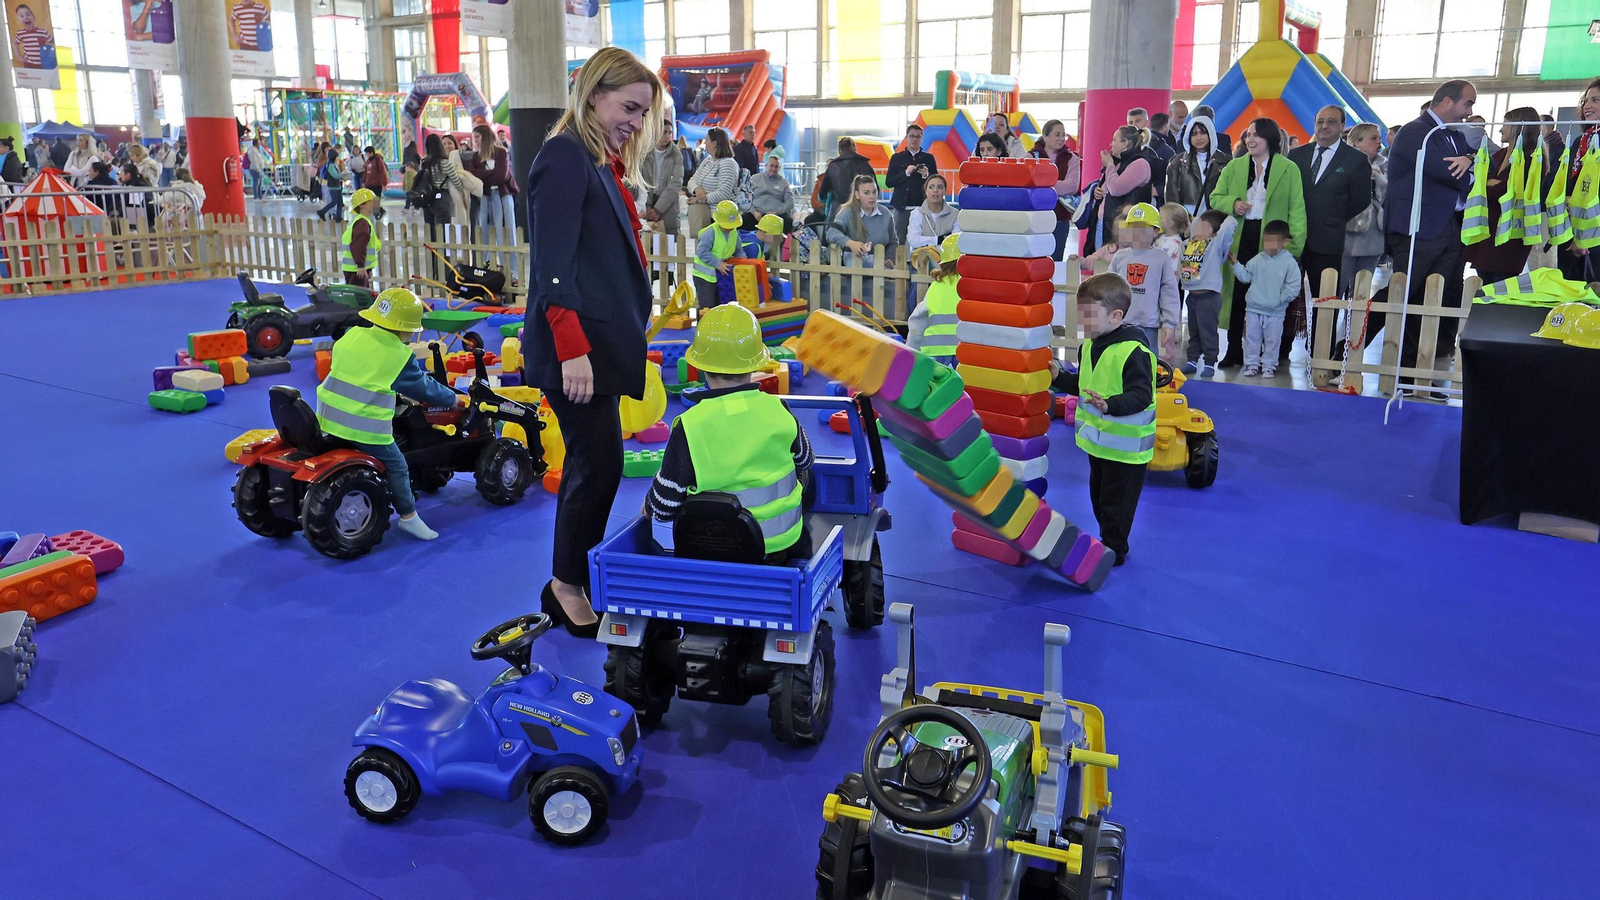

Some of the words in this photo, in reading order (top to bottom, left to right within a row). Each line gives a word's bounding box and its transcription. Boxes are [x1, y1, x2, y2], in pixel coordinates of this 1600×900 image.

[416, 76, 454, 92] FROZEN
[576, 692, 590, 704] BH
[510, 702, 524, 710] NEW
[524, 705, 550, 718] HOLLAND
